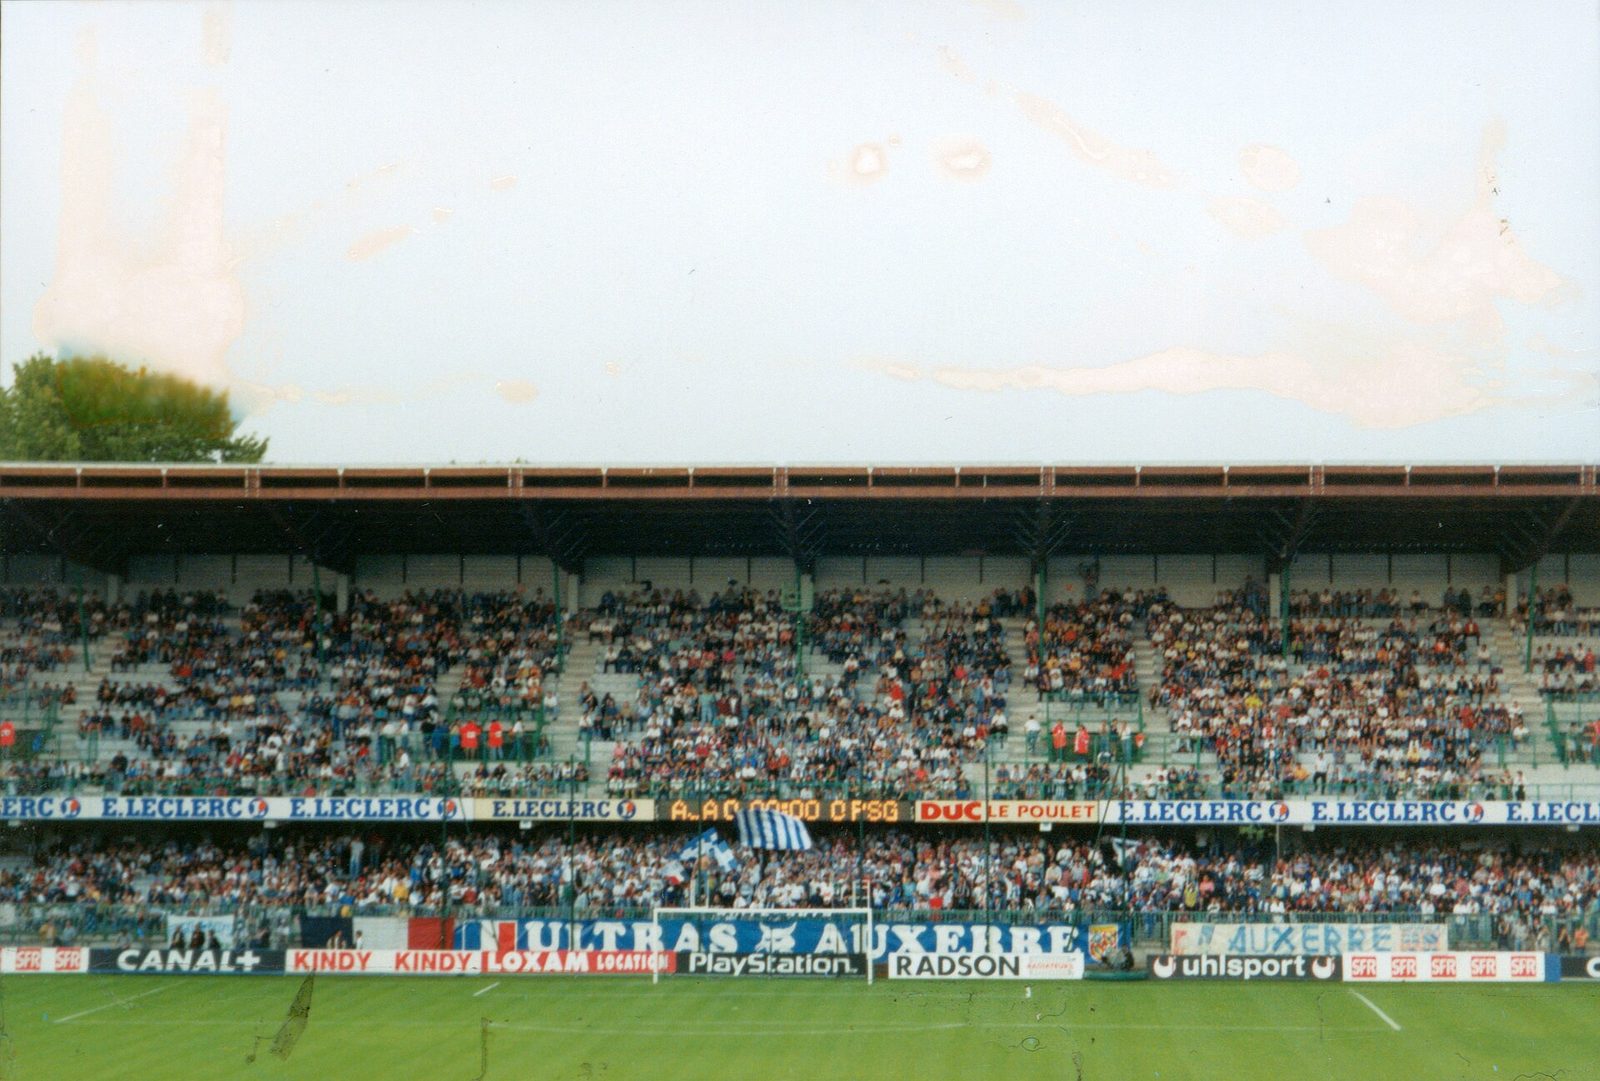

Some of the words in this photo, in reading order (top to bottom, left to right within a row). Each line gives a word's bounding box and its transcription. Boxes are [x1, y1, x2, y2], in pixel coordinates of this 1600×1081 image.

[102, 798, 242, 818] E.LECLERC
[290, 798, 430, 818] E.LECLERC
[493, 800, 610, 818] E.LECLERC
[920, 801, 982, 821] DUC
[988, 804, 1009, 818] LE
[1017, 804, 1095, 819] POULET
[1118, 801, 1262, 822] E.LECLERC
[1311, 801, 1456, 822] E.LECLERC
[1506, 801, 1600, 822] E.LECL
[524, 920, 738, 953] ULTRAS
[813, 922, 1083, 958] AUXERRE
[1227, 923, 1393, 954] AUXERRE
[16, 950, 41, 969] SFR
[55, 950, 81, 969] SFR
[116, 949, 261, 972] CANAL+
[293, 951, 372, 971] KINDY
[394, 952, 472, 971] KINDY
[487, 951, 589, 972] LOXAM
[689, 952, 850, 976] PlayStation
[896, 955, 1020, 976] RADSON
[1182, 953, 1306, 980] uhlsport
[1351, 957, 1376, 977] SFR
[1391, 957, 1416, 977] SFR
[1431, 957, 1456, 977] SFR
[1471, 957, 1496, 977] SFR
[1511, 957, 1536, 977] SFR
